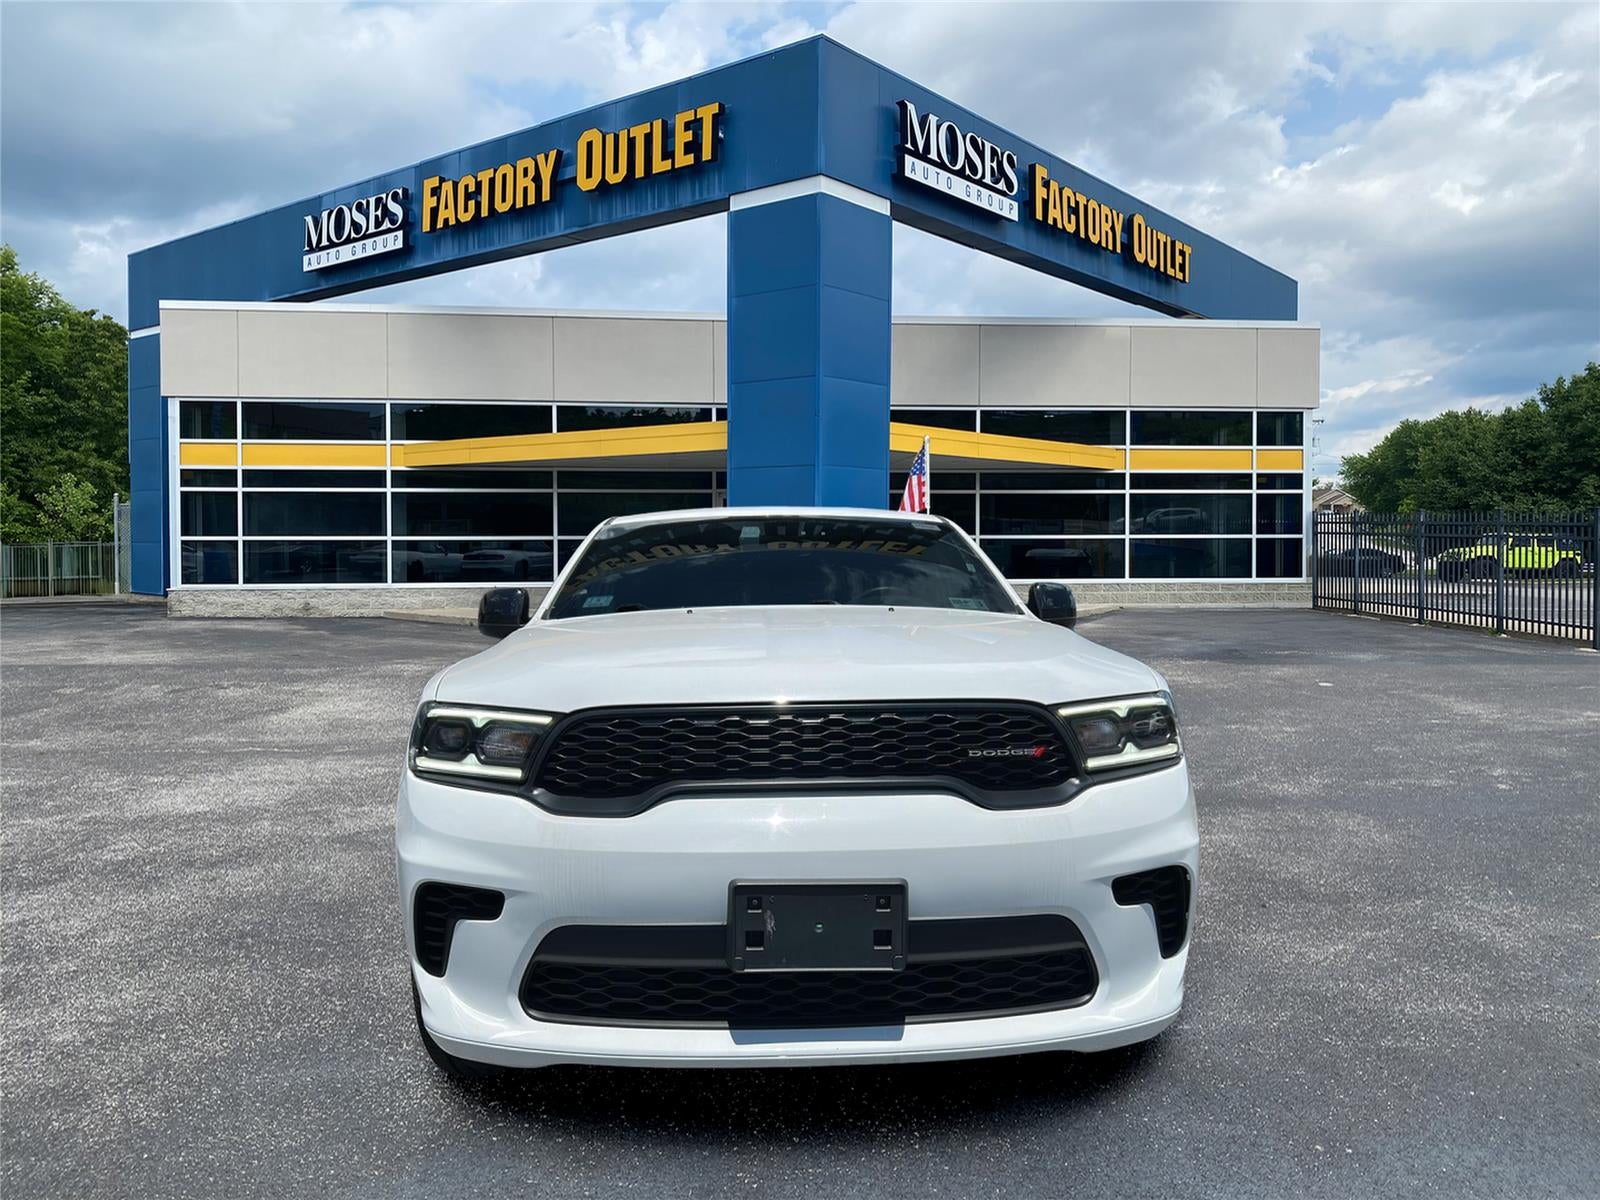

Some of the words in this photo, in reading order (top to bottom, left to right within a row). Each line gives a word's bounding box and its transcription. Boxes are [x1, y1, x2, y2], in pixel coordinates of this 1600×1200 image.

[421, 149, 560, 232] FACTORY
[576, 102, 720, 192] OUTLET
[904, 100, 1019, 196] MOSES
[910, 161, 953, 190] AUTO
[965, 184, 1015, 214] GROUP
[303, 187, 404, 251] MOSES
[307, 249, 340, 268] AUTO
[351, 234, 399, 256] GROUP
[1035, 163, 1124, 254] FACTORY
[1131, 213, 1192, 283] OUTLET
